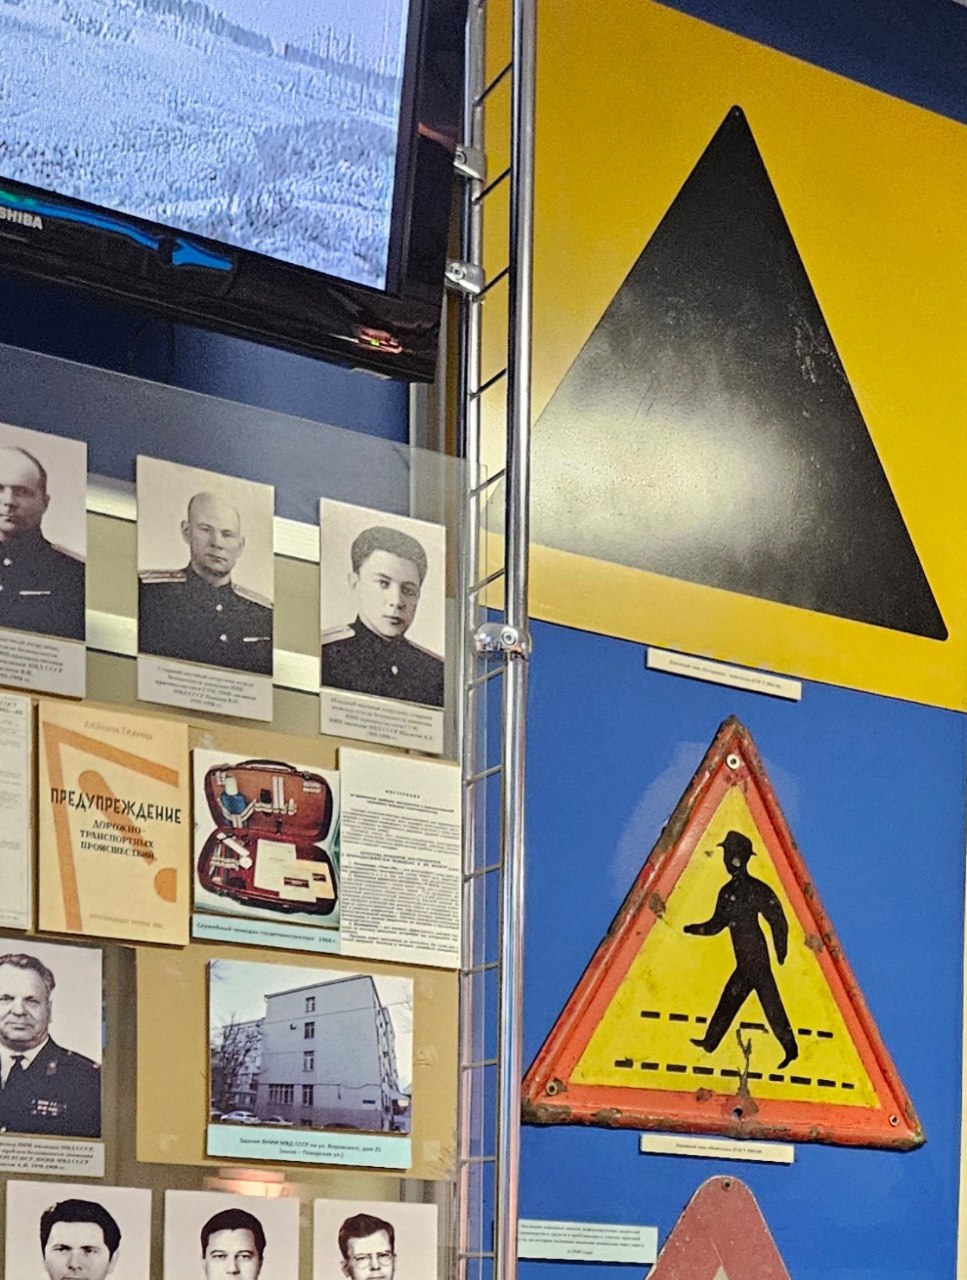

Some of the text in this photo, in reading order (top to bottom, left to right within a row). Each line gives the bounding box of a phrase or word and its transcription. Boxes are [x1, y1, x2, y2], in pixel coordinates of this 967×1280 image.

[51, 787, 182, 824] ПРЕДУПРЕЖДЕНИЕ
[79, 830, 155, 848] ТРАНСПОРТНЫХ
[80, 841, 155, 859] ПРОИСШЕСТВИЙ
